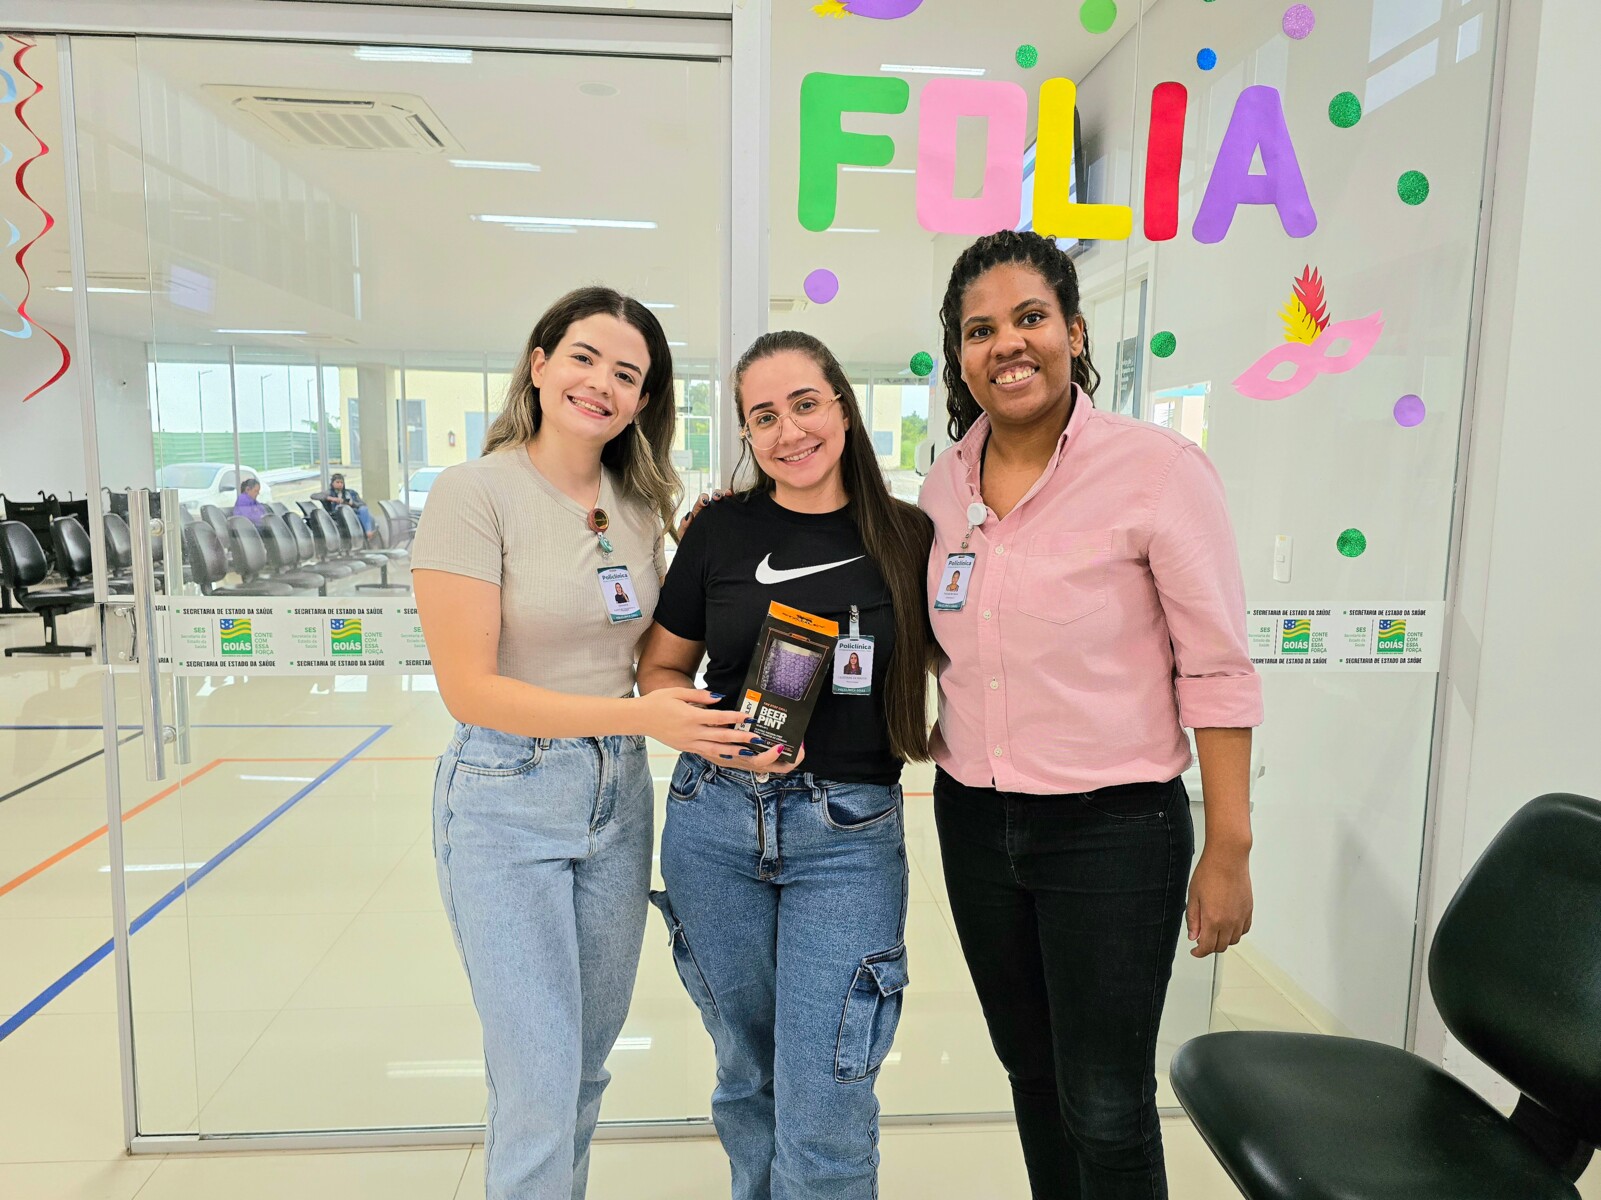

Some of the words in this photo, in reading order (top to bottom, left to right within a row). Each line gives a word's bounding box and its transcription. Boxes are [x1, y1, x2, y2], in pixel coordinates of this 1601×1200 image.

[797, 71, 1318, 244] FOLIA
[223, 640, 251, 651] GOIÁS
[333, 640, 361, 650] GOIÁS
[1283, 639, 1308, 649] GOIÁS
[1379, 639, 1403, 649] GOIÁS
[760, 706, 788, 722] BEER
[757, 715, 784, 730] PINT
